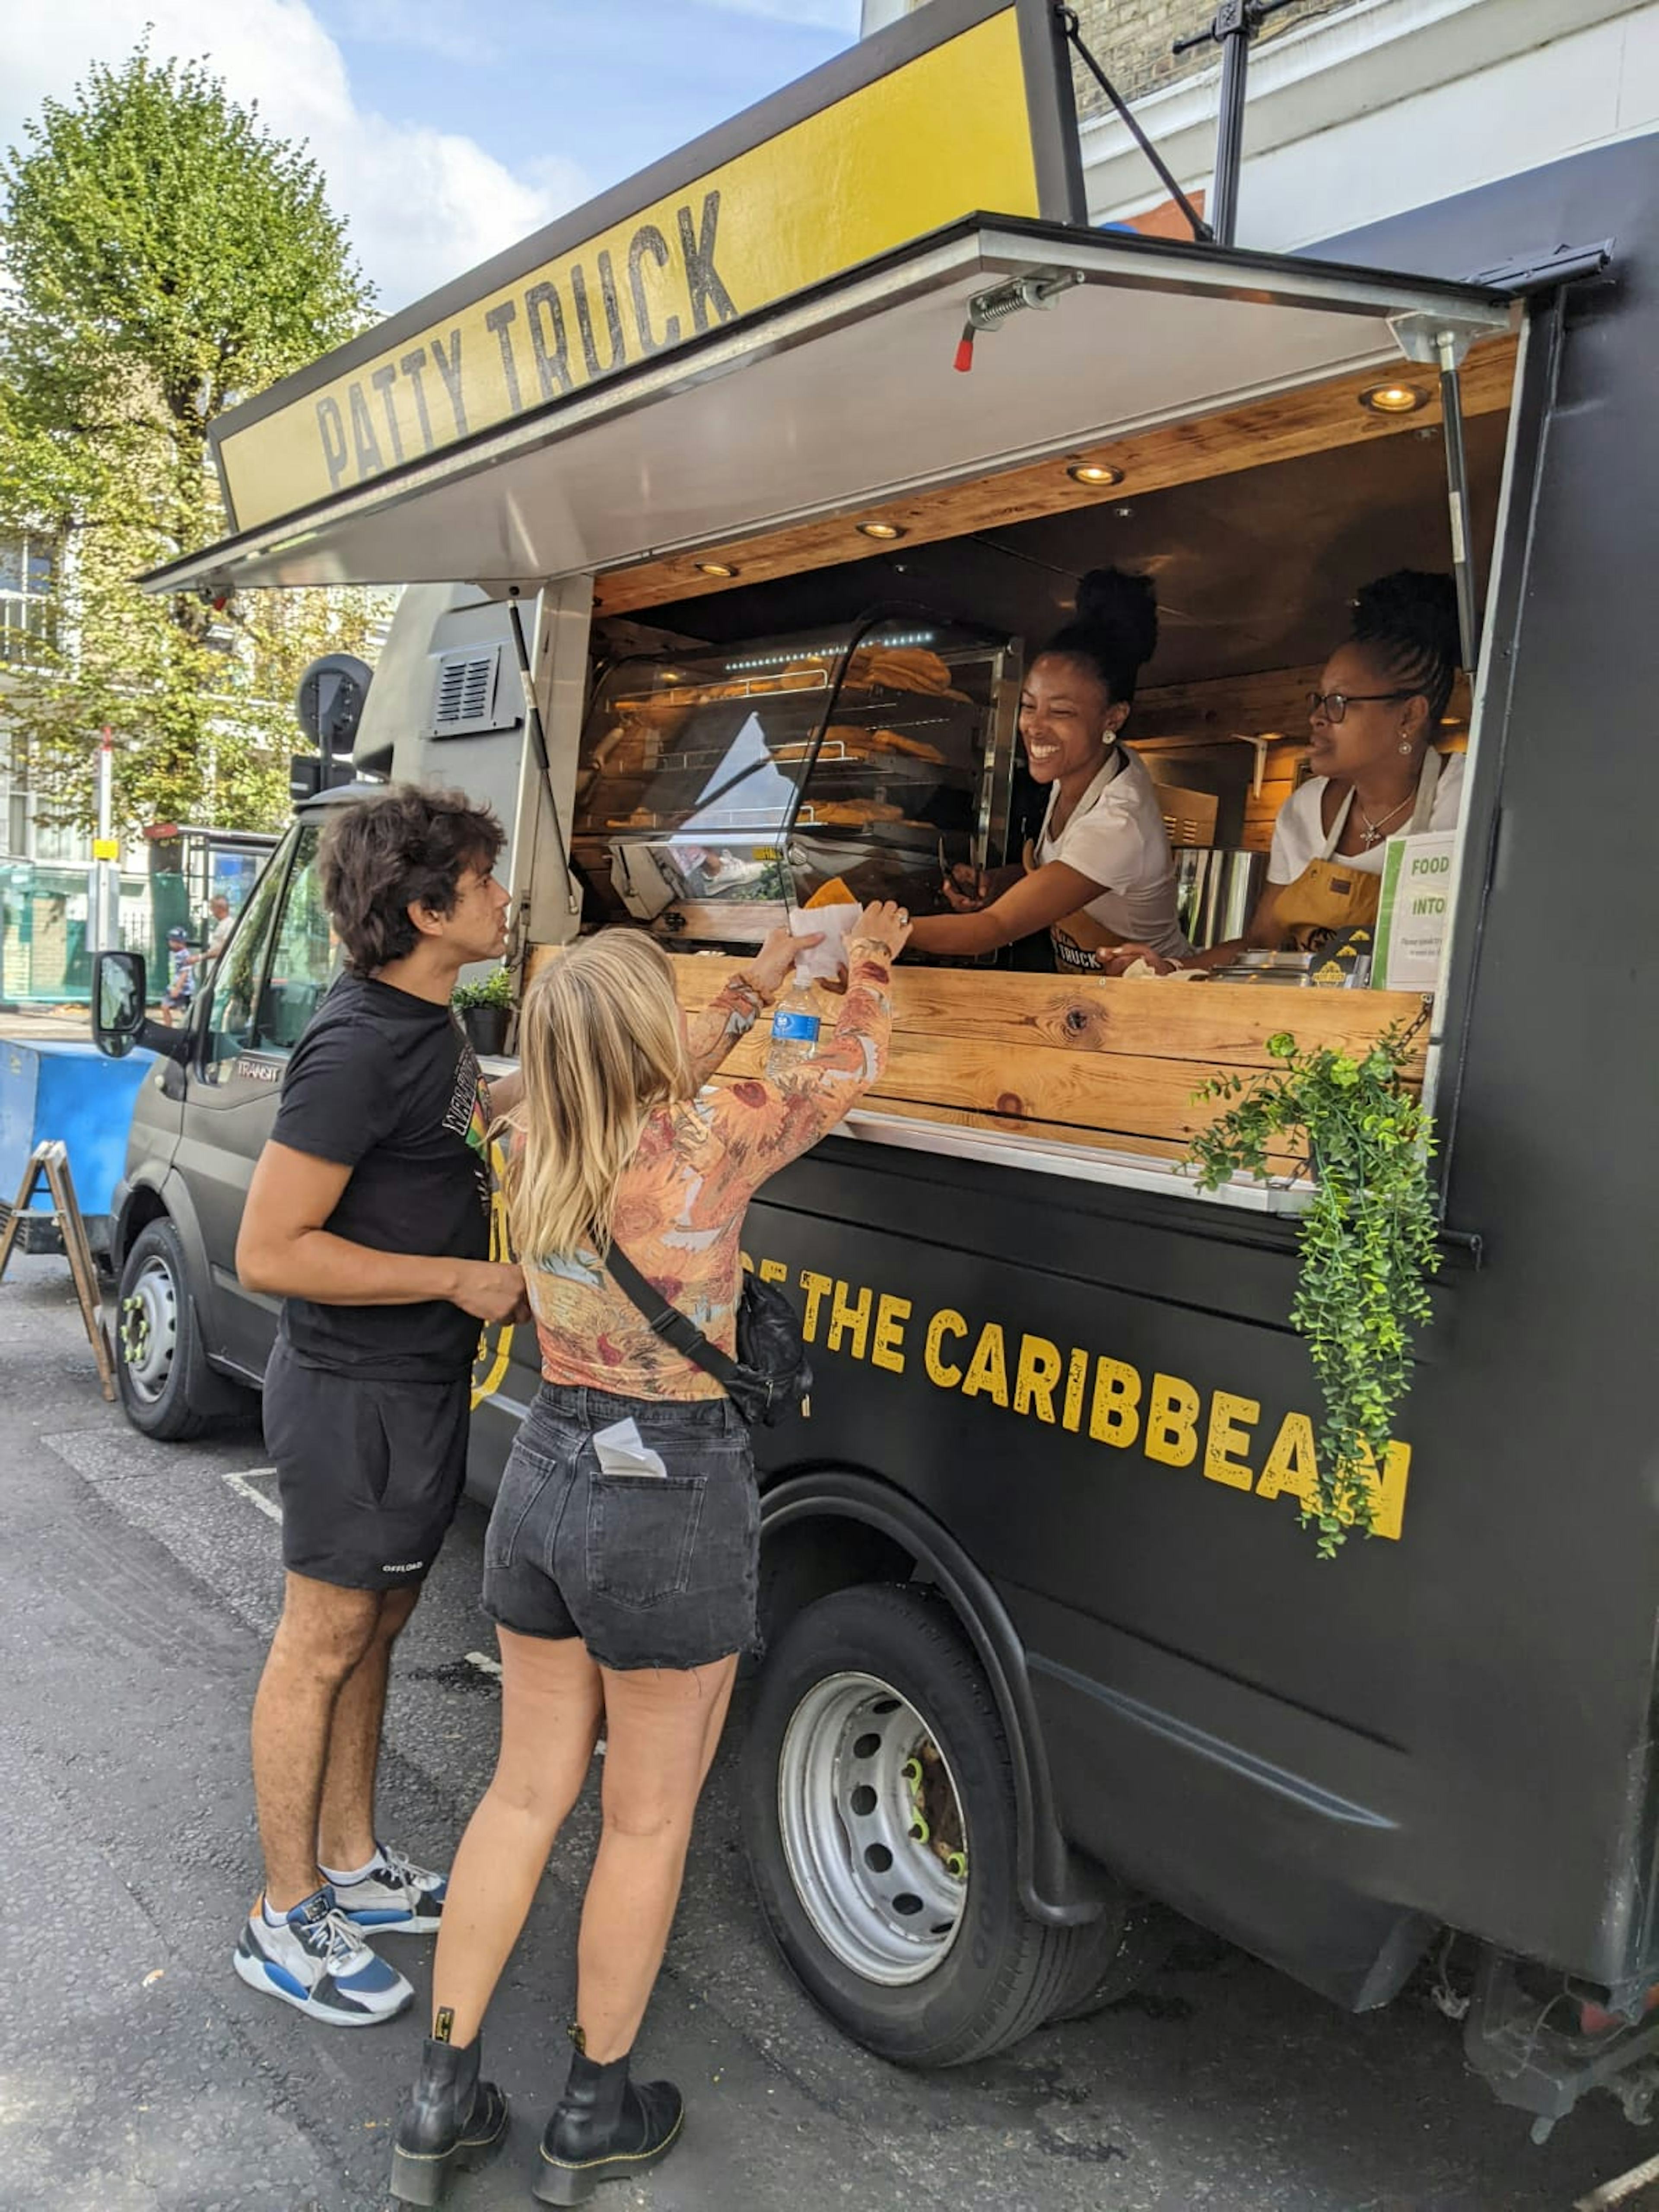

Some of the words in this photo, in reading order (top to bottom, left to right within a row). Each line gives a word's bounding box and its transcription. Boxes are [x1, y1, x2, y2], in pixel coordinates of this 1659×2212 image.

[315, 329, 467, 492] PATTY
[486, 190, 739, 411] TRUCK
[1411, 856, 1449, 876] FOOD
[1412, 898, 1445, 915] INTO
[1058, 944, 1101, 968] TRUCK
[238, 1060, 280, 1082] TRANSIT
[800, 1269, 912, 1373] THE
[924, 1308, 1411, 1541] CARIBBEAN
